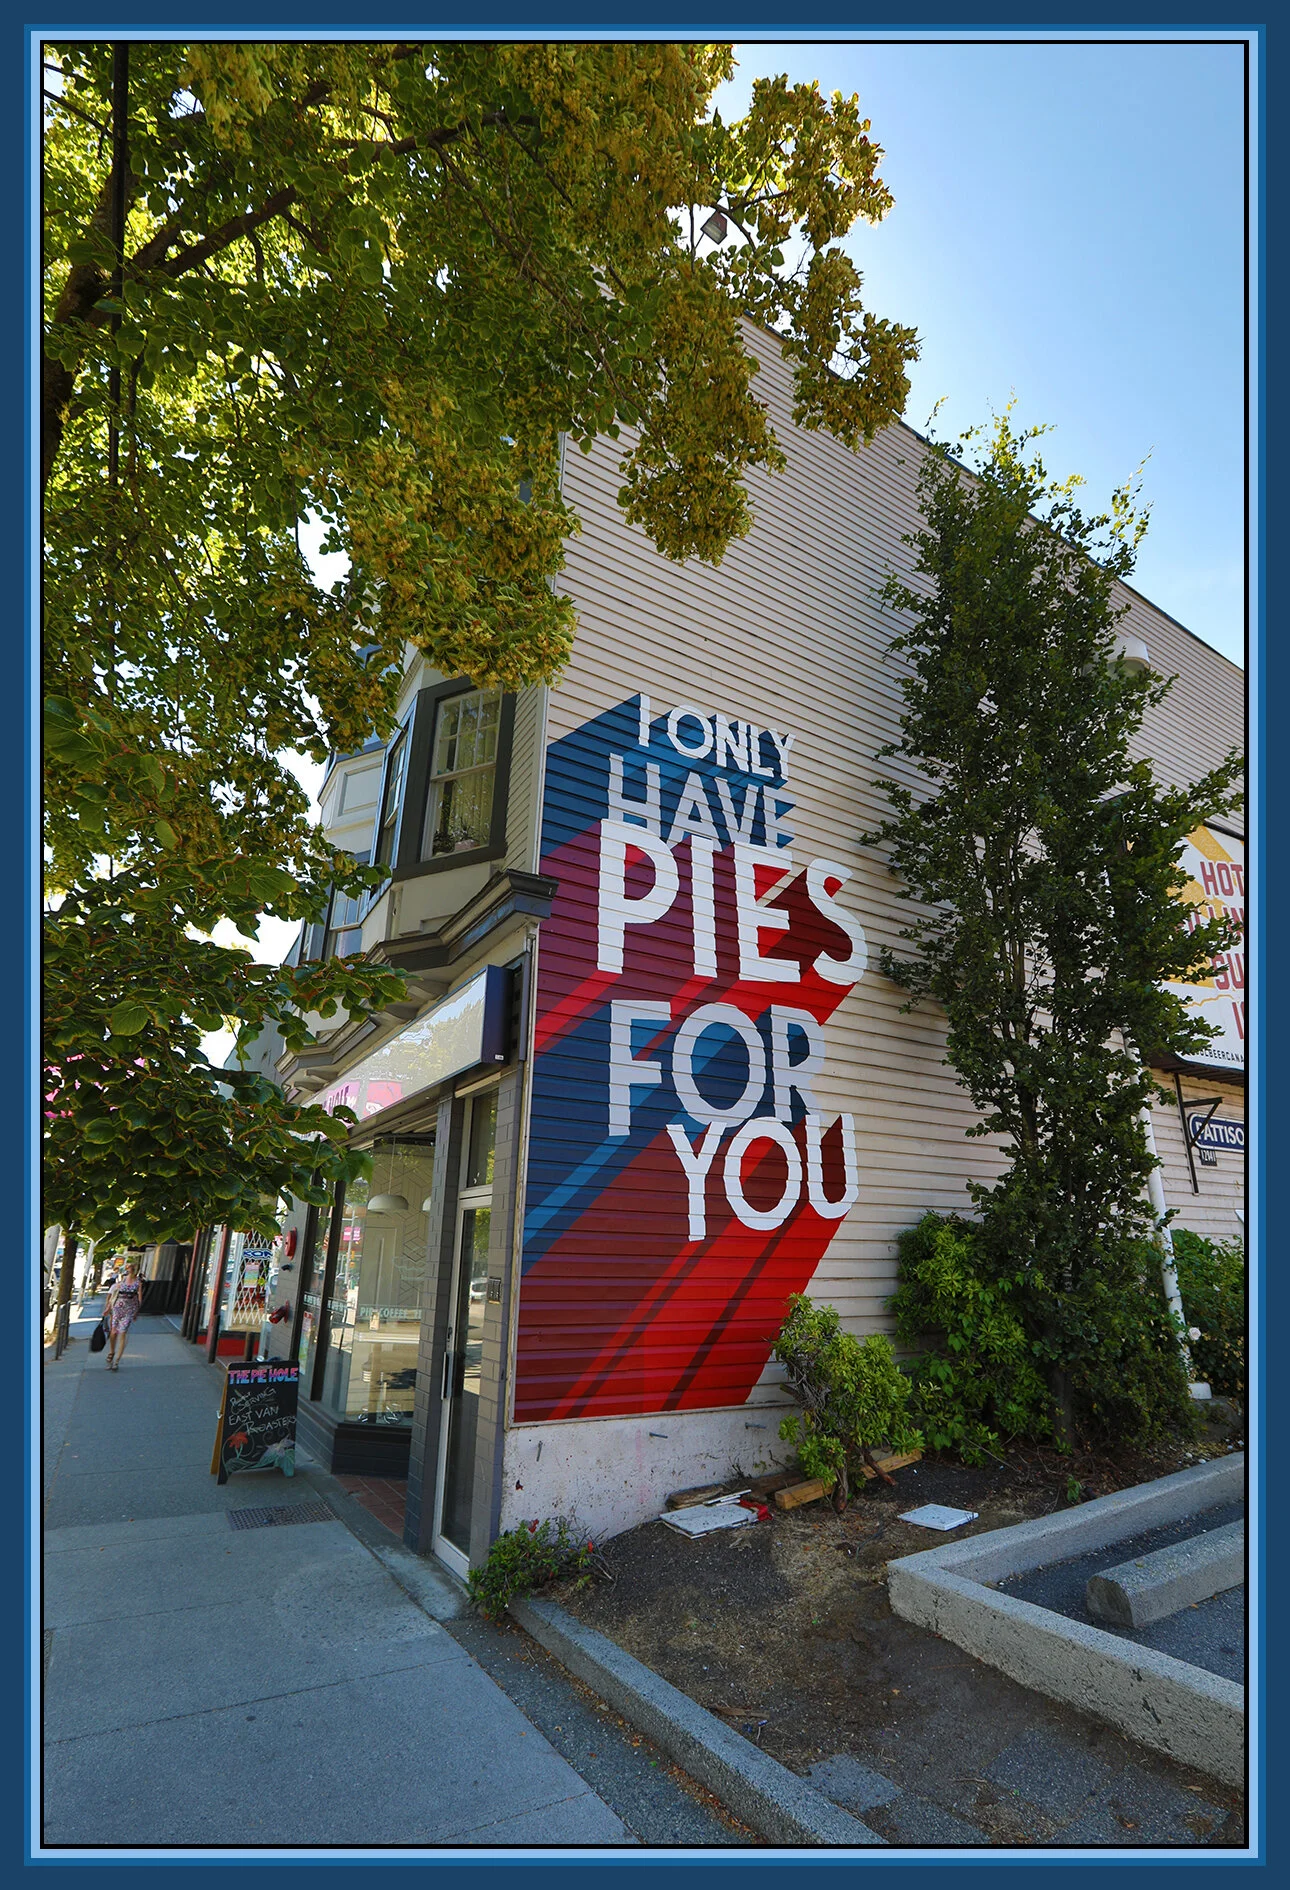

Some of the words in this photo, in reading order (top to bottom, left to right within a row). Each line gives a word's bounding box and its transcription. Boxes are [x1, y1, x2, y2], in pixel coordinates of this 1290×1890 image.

[638, 693, 651, 748] I
[665, 705, 796, 782] ONLY
[608, 753, 796, 851] HAVE
[597, 818, 867, 985] PIES
[1200, 861, 1244, 896] HOT
[1211, 952, 1244, 990] SU
[608, 1000, 826, 1137] FOR
[666, 1113, 859, 1241] YOU
[228, 1410, 253, 1426] EAST
[255, 1406, 280, 1419] VAN
[245, 1415, 297, 1435] ROASTERS
